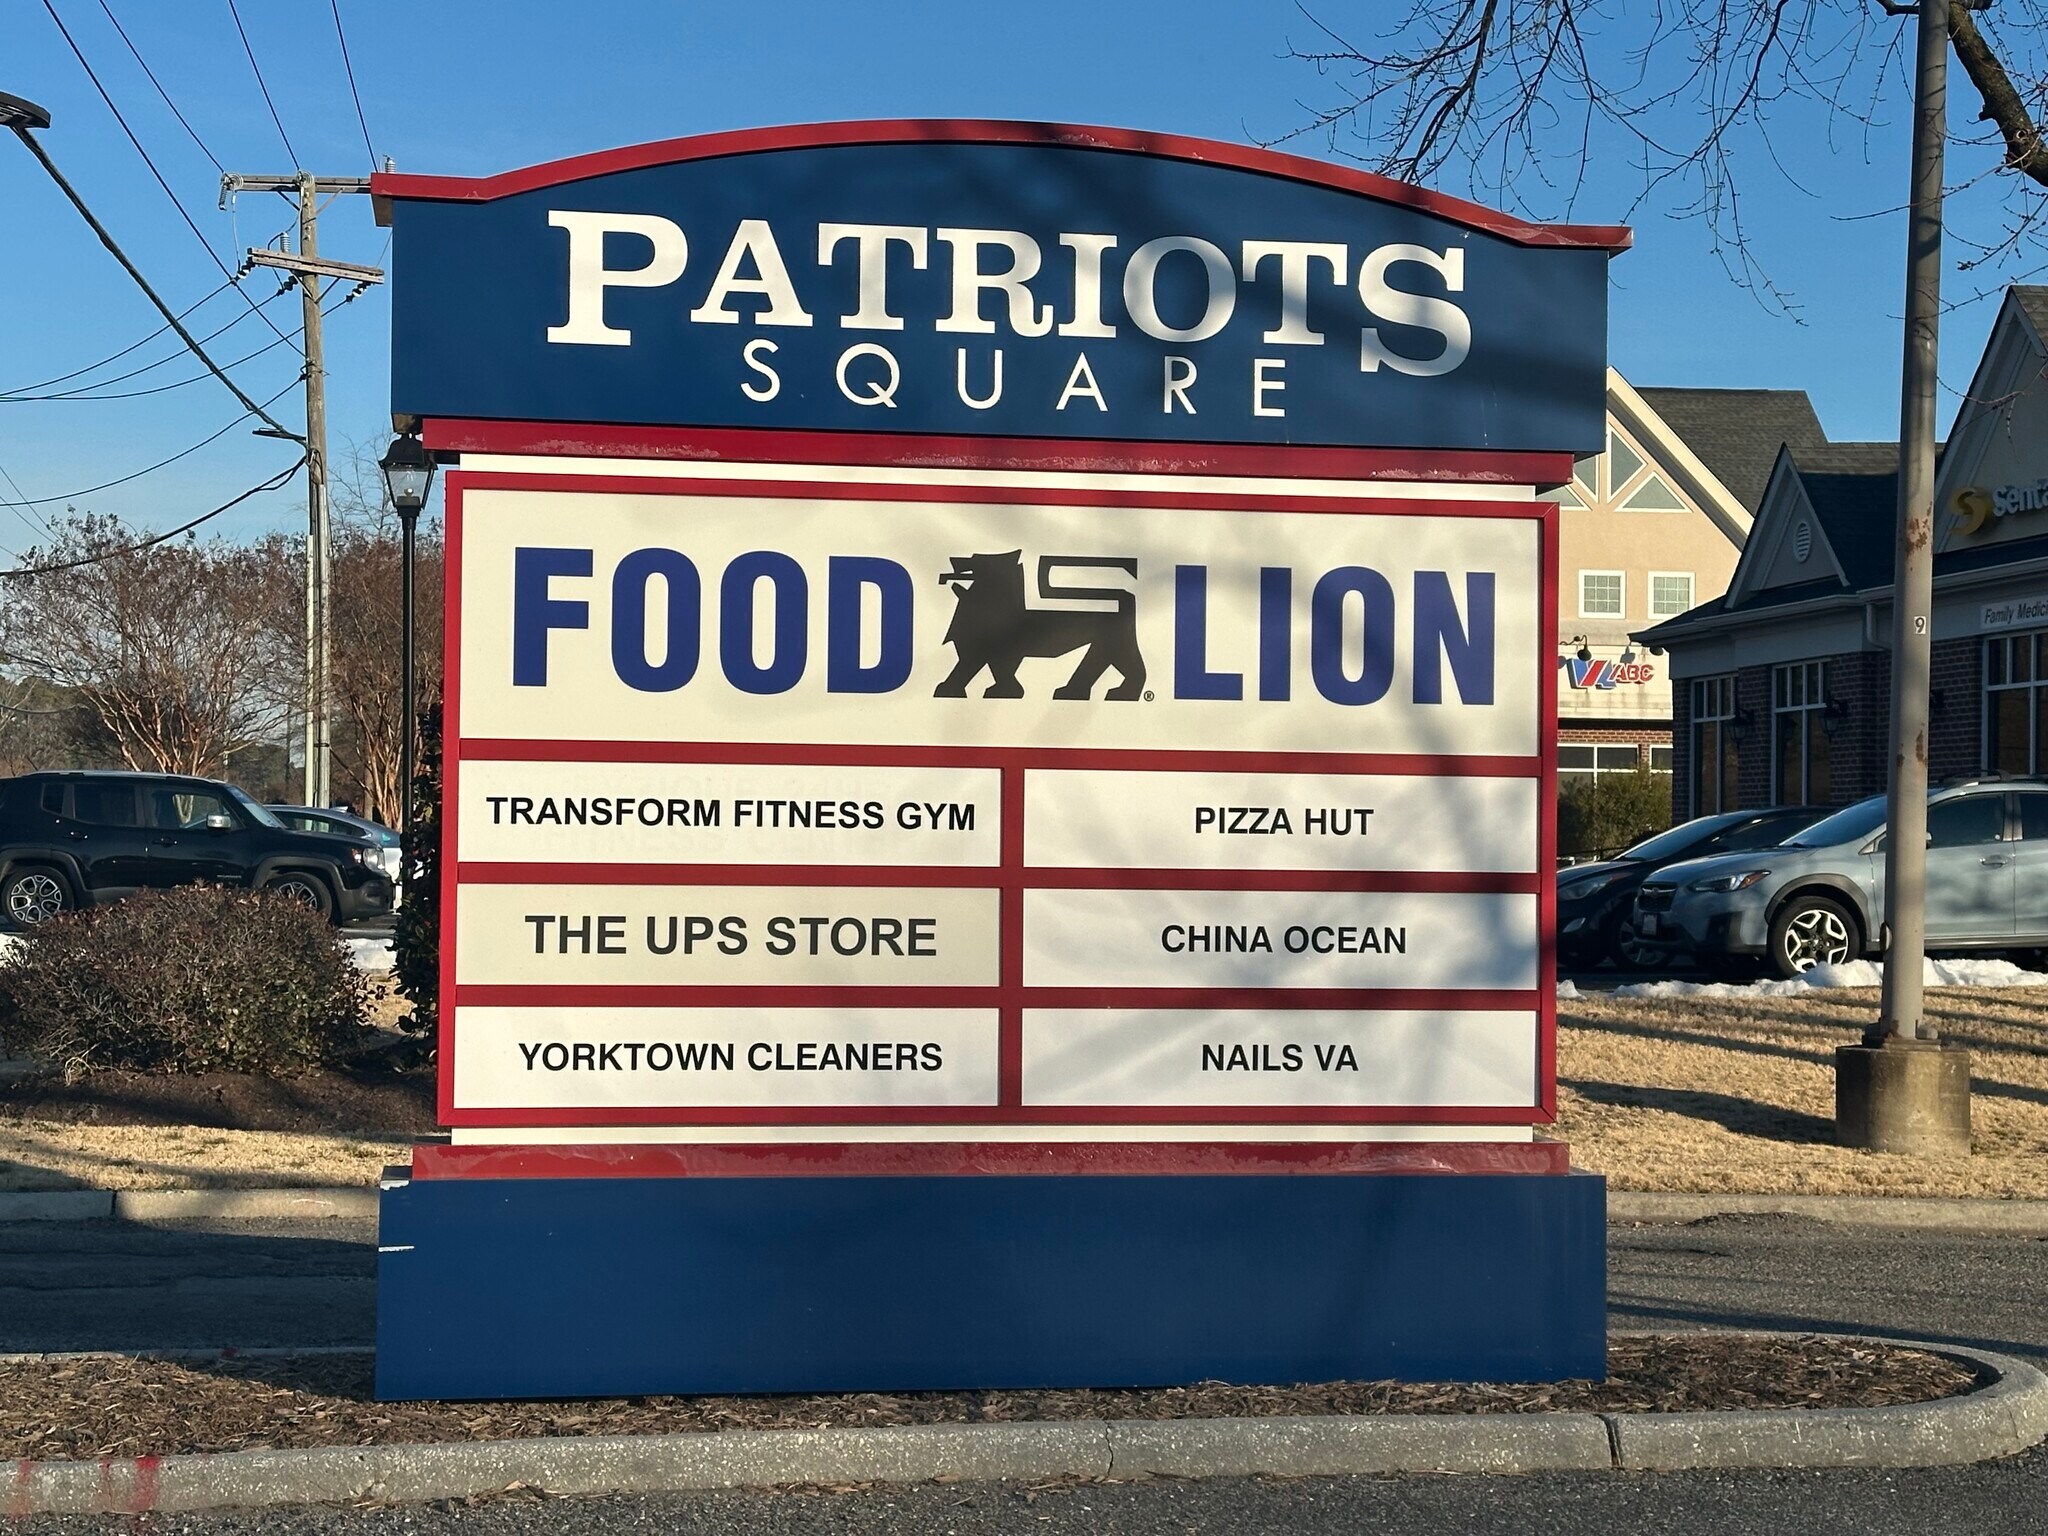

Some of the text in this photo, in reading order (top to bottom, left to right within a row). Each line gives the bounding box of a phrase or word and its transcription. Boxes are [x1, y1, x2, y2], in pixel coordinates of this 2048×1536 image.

[547, 210, 1472, 377] PATRIOTS
[740, 339, 1286, 418] SQUARE
[513, 547, 1495, 706] FOOD LION
[1915, 617, 1925, 633] 9
[1984, 605, 2014, 624] Family
[1609, 663, 1655, 683] ABC
[486, 797, 974, 830] TRANSFORM FITNESS GYM
[1195, 807, 1374, 835] PIZZA HUT
[525, 916, 936, 956] THE UPS STORE
[1162, 925, 1405, 953] CHINA OCEAN
[519, 1043, 942, 1071] YORKTOWN CLEANERS
[1203, 1044, 1358, 1071] NAILS VA
